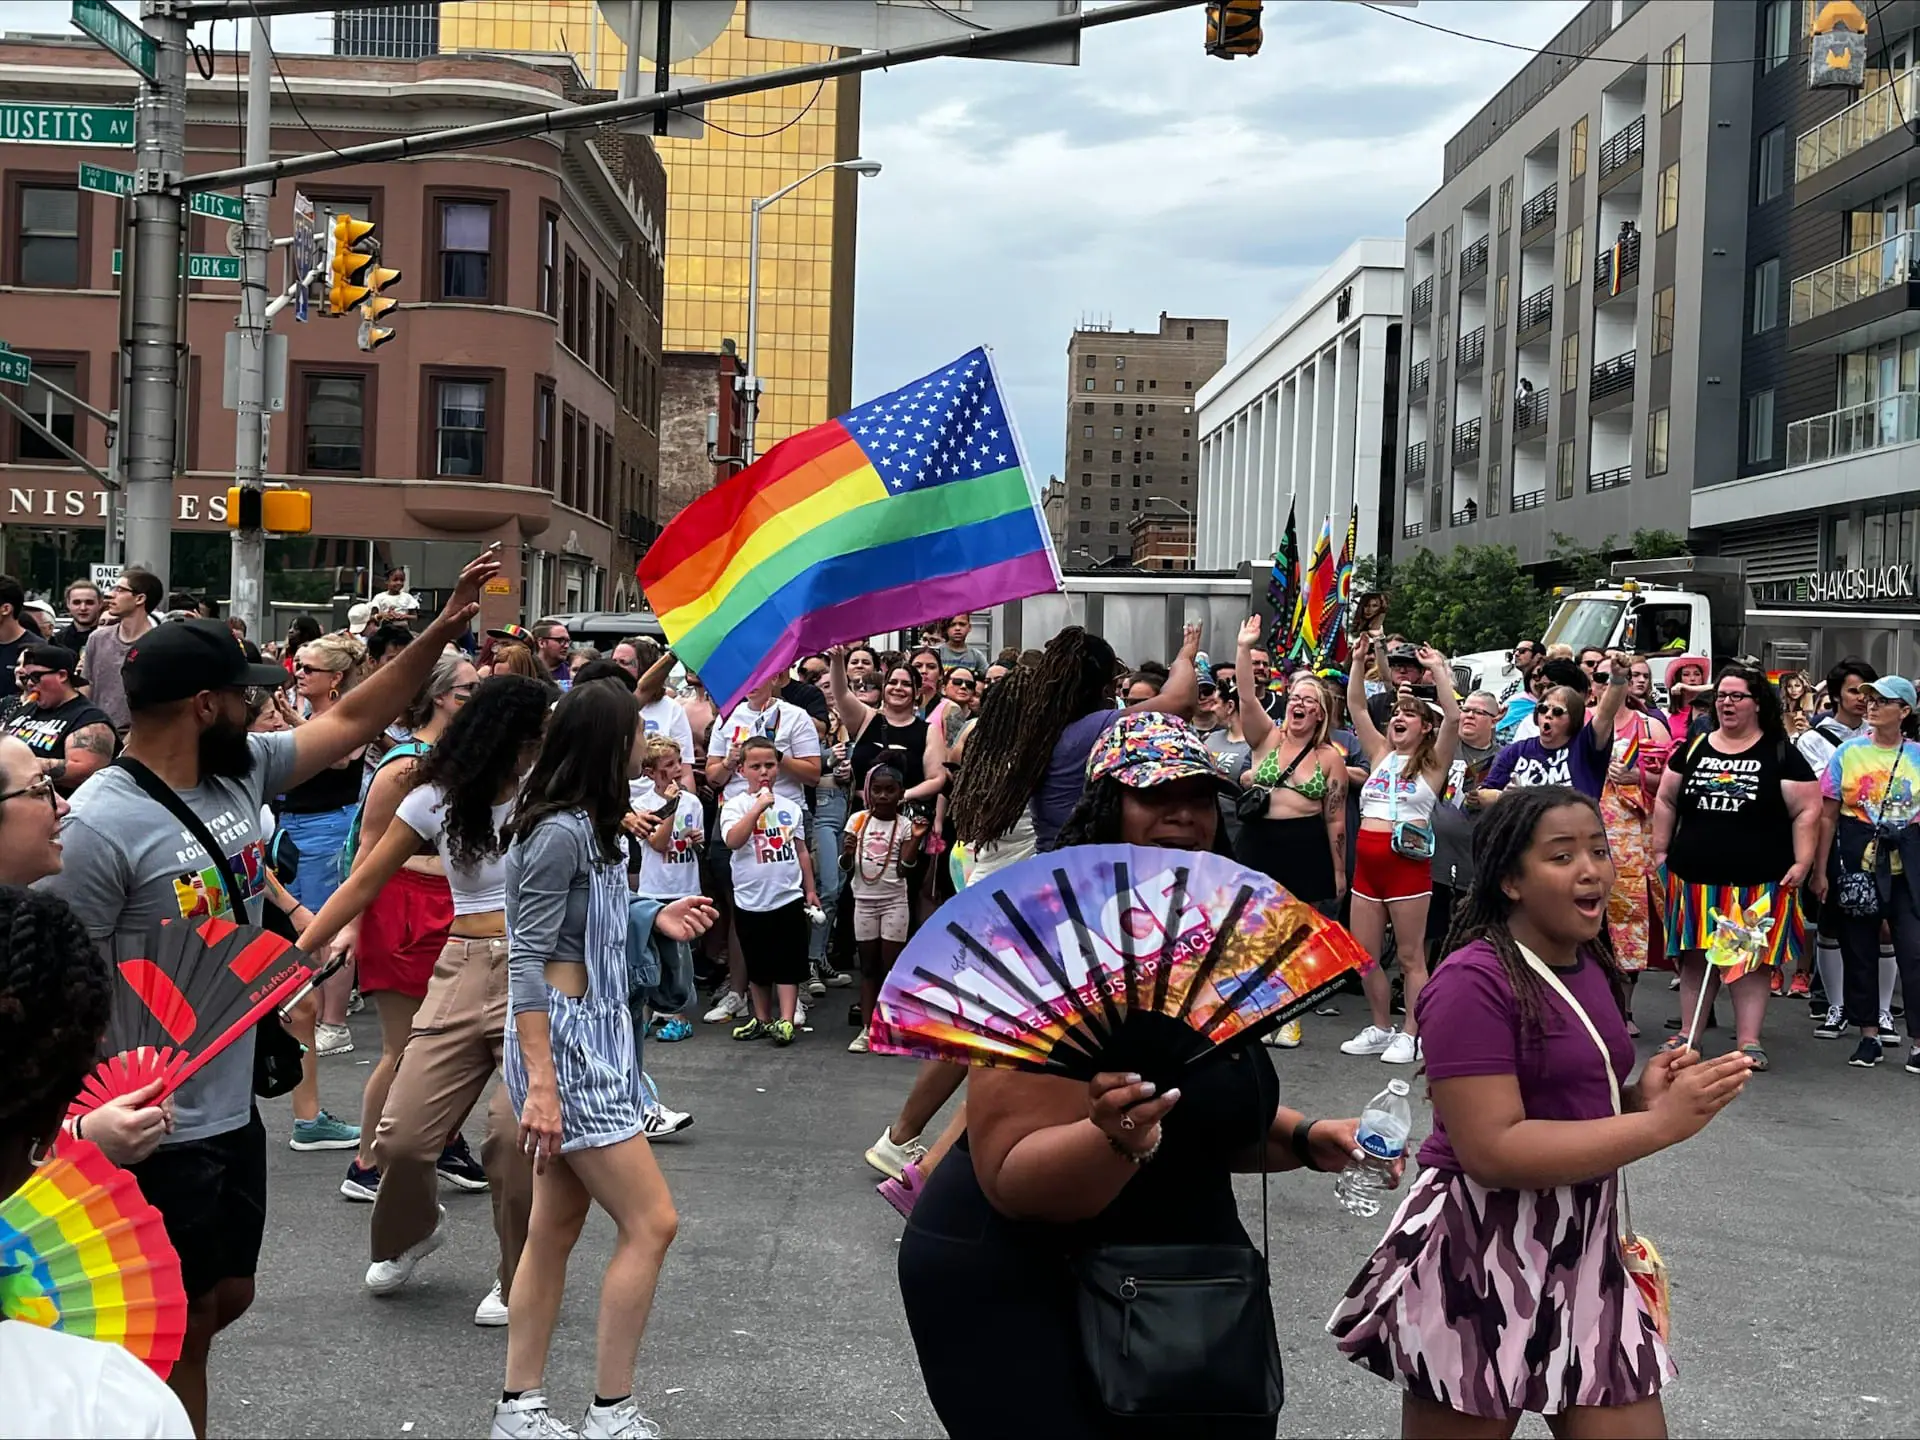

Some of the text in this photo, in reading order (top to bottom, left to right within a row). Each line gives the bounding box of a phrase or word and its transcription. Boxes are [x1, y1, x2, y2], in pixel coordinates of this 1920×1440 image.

[0, 111, 128, 140] USETTS AV
[90, 177, 97, 187] N
[224, 264, 236, 273] ST
[15, 361, 27, 378] St
[96, 567, 119, 577] ONE
[1809, 564, 1913, 602] SHAKE SHACK
[1697, 757, 1761, 772] PROUD
[1697, 796, 1745, 812] ALLY
[1364, 1141, 1386, 1154] WATER
